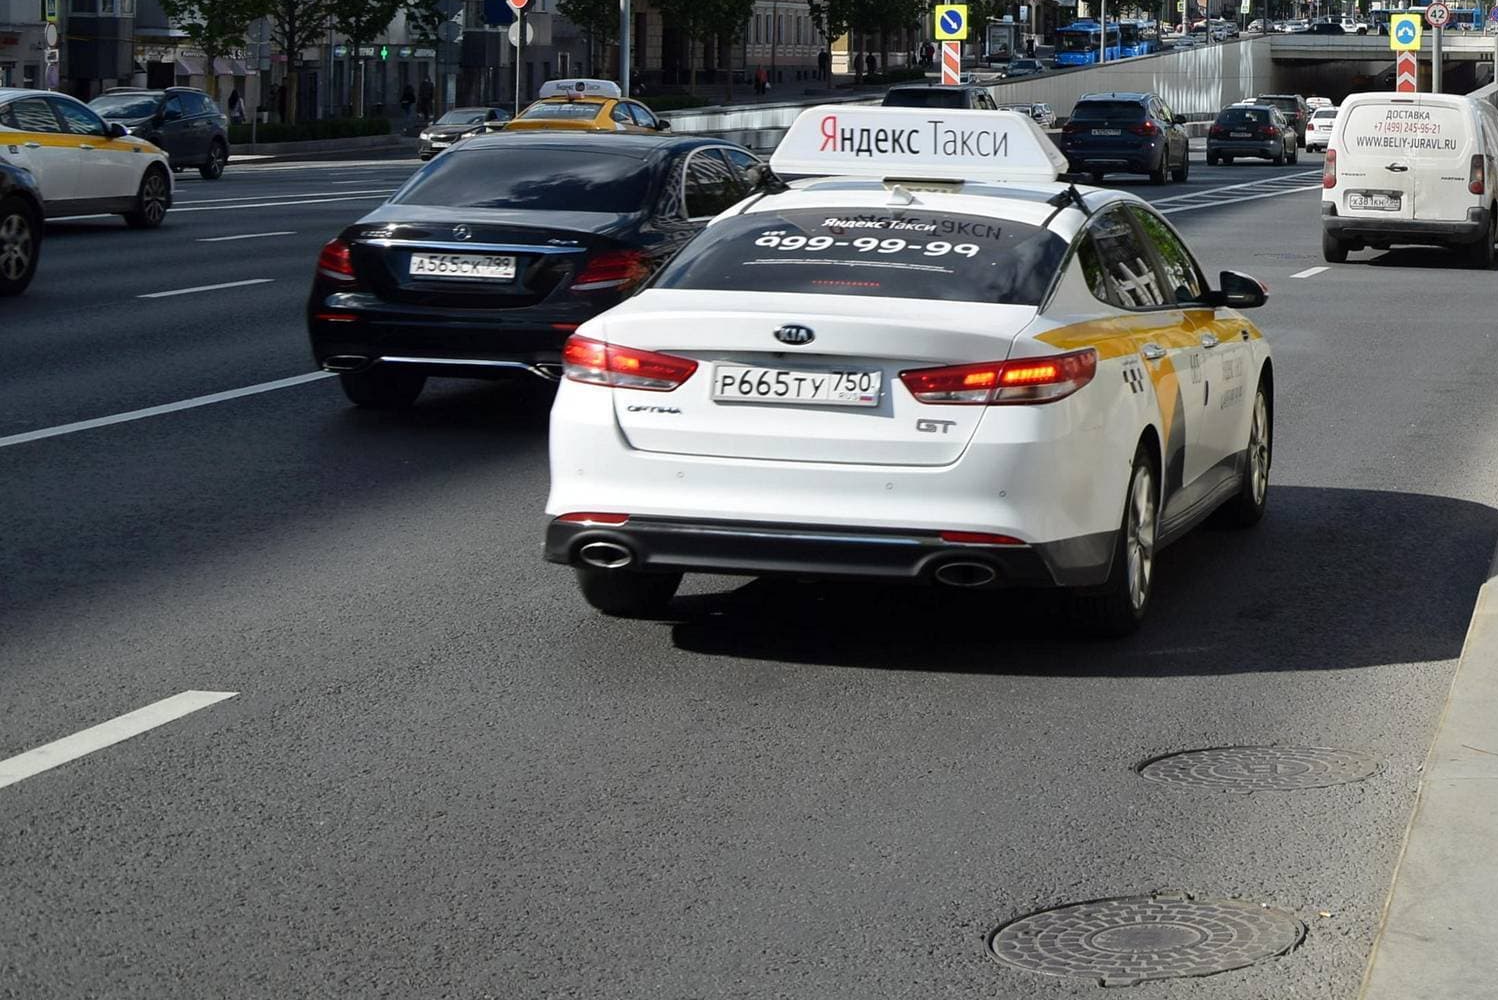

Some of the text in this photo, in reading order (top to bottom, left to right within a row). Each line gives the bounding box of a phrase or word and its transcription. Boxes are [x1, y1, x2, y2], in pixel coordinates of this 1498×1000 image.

[1385, 109, 1430, 121] ДОСТАВКА
[1373, 122, 1441, 135] +7 (499) 245-96-21
[819, 115, 1008, 158] Яндекс Такси
[1356, 136, 1457, 150] WWW.BELIY-JURAVL.RU
[821, 217, 888, 230] Яндекс
[888, 219, 938, 232] Такси
[778, 328, 809, 342] KIA
[832, 370, 872, 393] 750
[915, 417, 957, 435] GT
